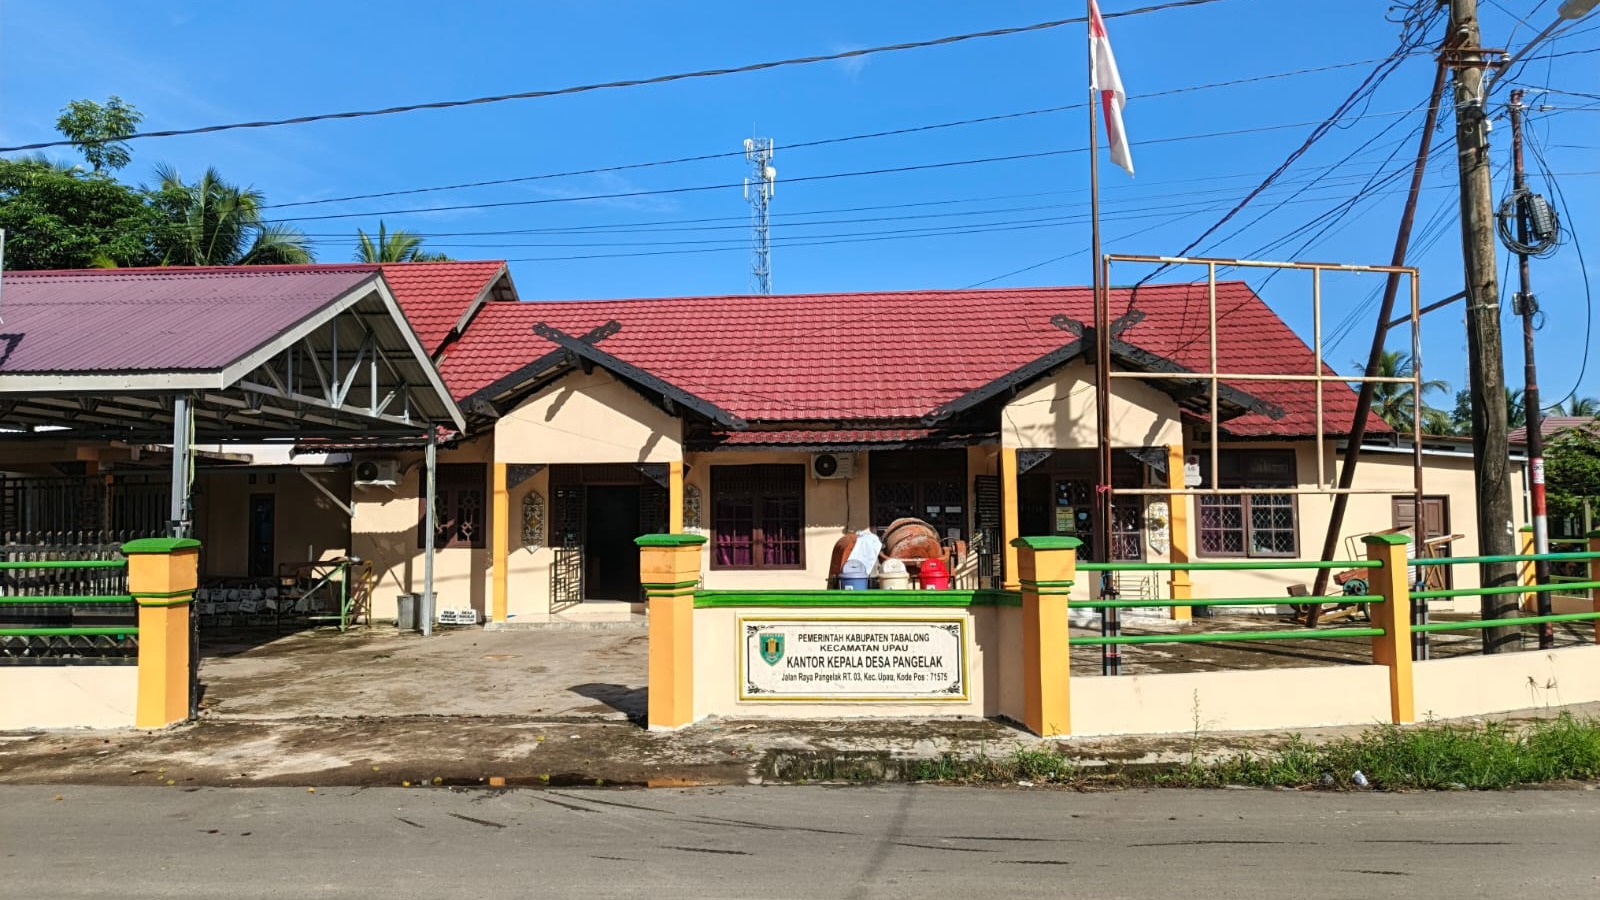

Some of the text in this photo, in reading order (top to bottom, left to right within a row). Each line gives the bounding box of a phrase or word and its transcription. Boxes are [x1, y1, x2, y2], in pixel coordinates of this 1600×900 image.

[798, 633, 930, 643] PEMERINTAH KABUPATEN TABALONG
[820, 644, 909, 652] KECAMATAN UPAU
[786, 656, 943, 669] KANTOR KEPALA DESA PANGELAK
[781, 672, 797, 681] Jalan
[798, 672, 813, 683] Raya
[814, 672, 841, 683] Pangelak
[896, 672, 912, 681] Kode
[913, 672, 925, 681] Pos
